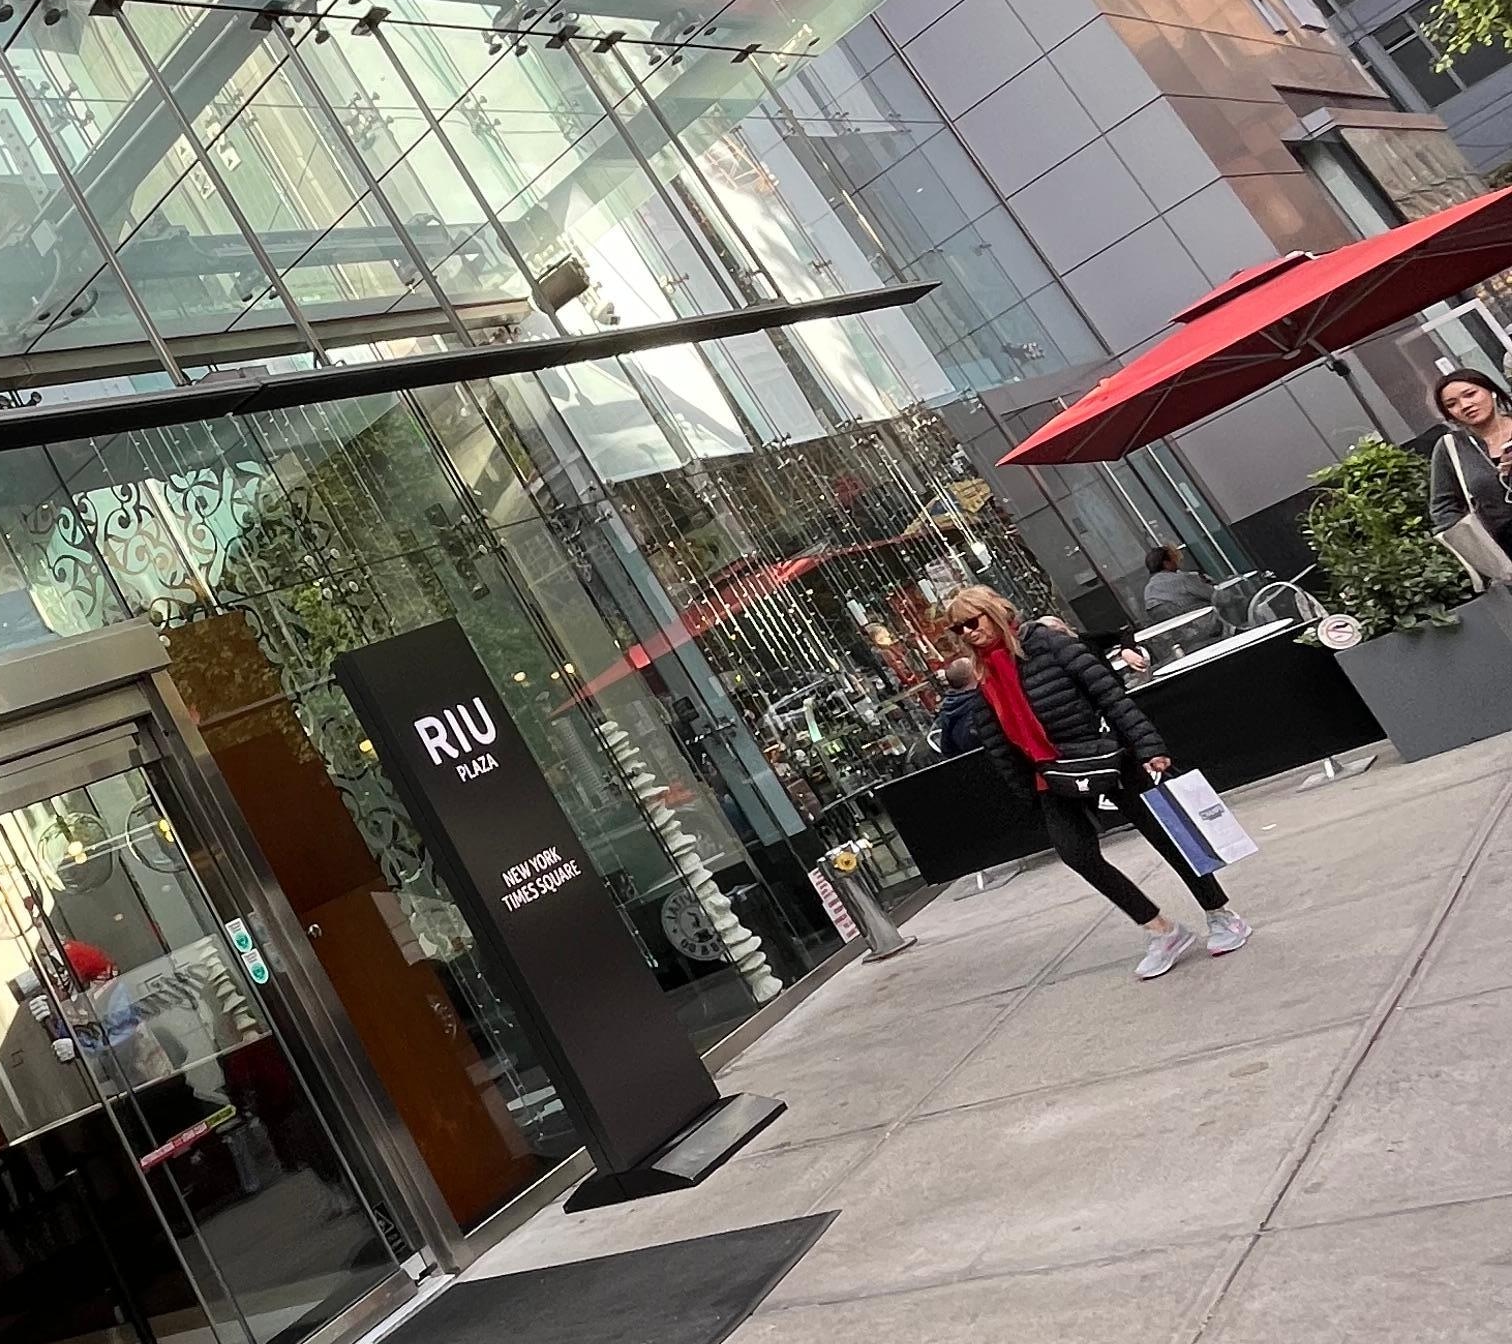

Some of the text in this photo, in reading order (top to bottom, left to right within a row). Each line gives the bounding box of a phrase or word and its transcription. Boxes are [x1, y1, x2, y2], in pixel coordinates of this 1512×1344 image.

[414, 697, 497, 766] RIU
[455, 753, 499, 782] PLAZA
[501, 859, 582, 912] TIMES SQUARE
[502, 846, 562, 888] NEW YORK
